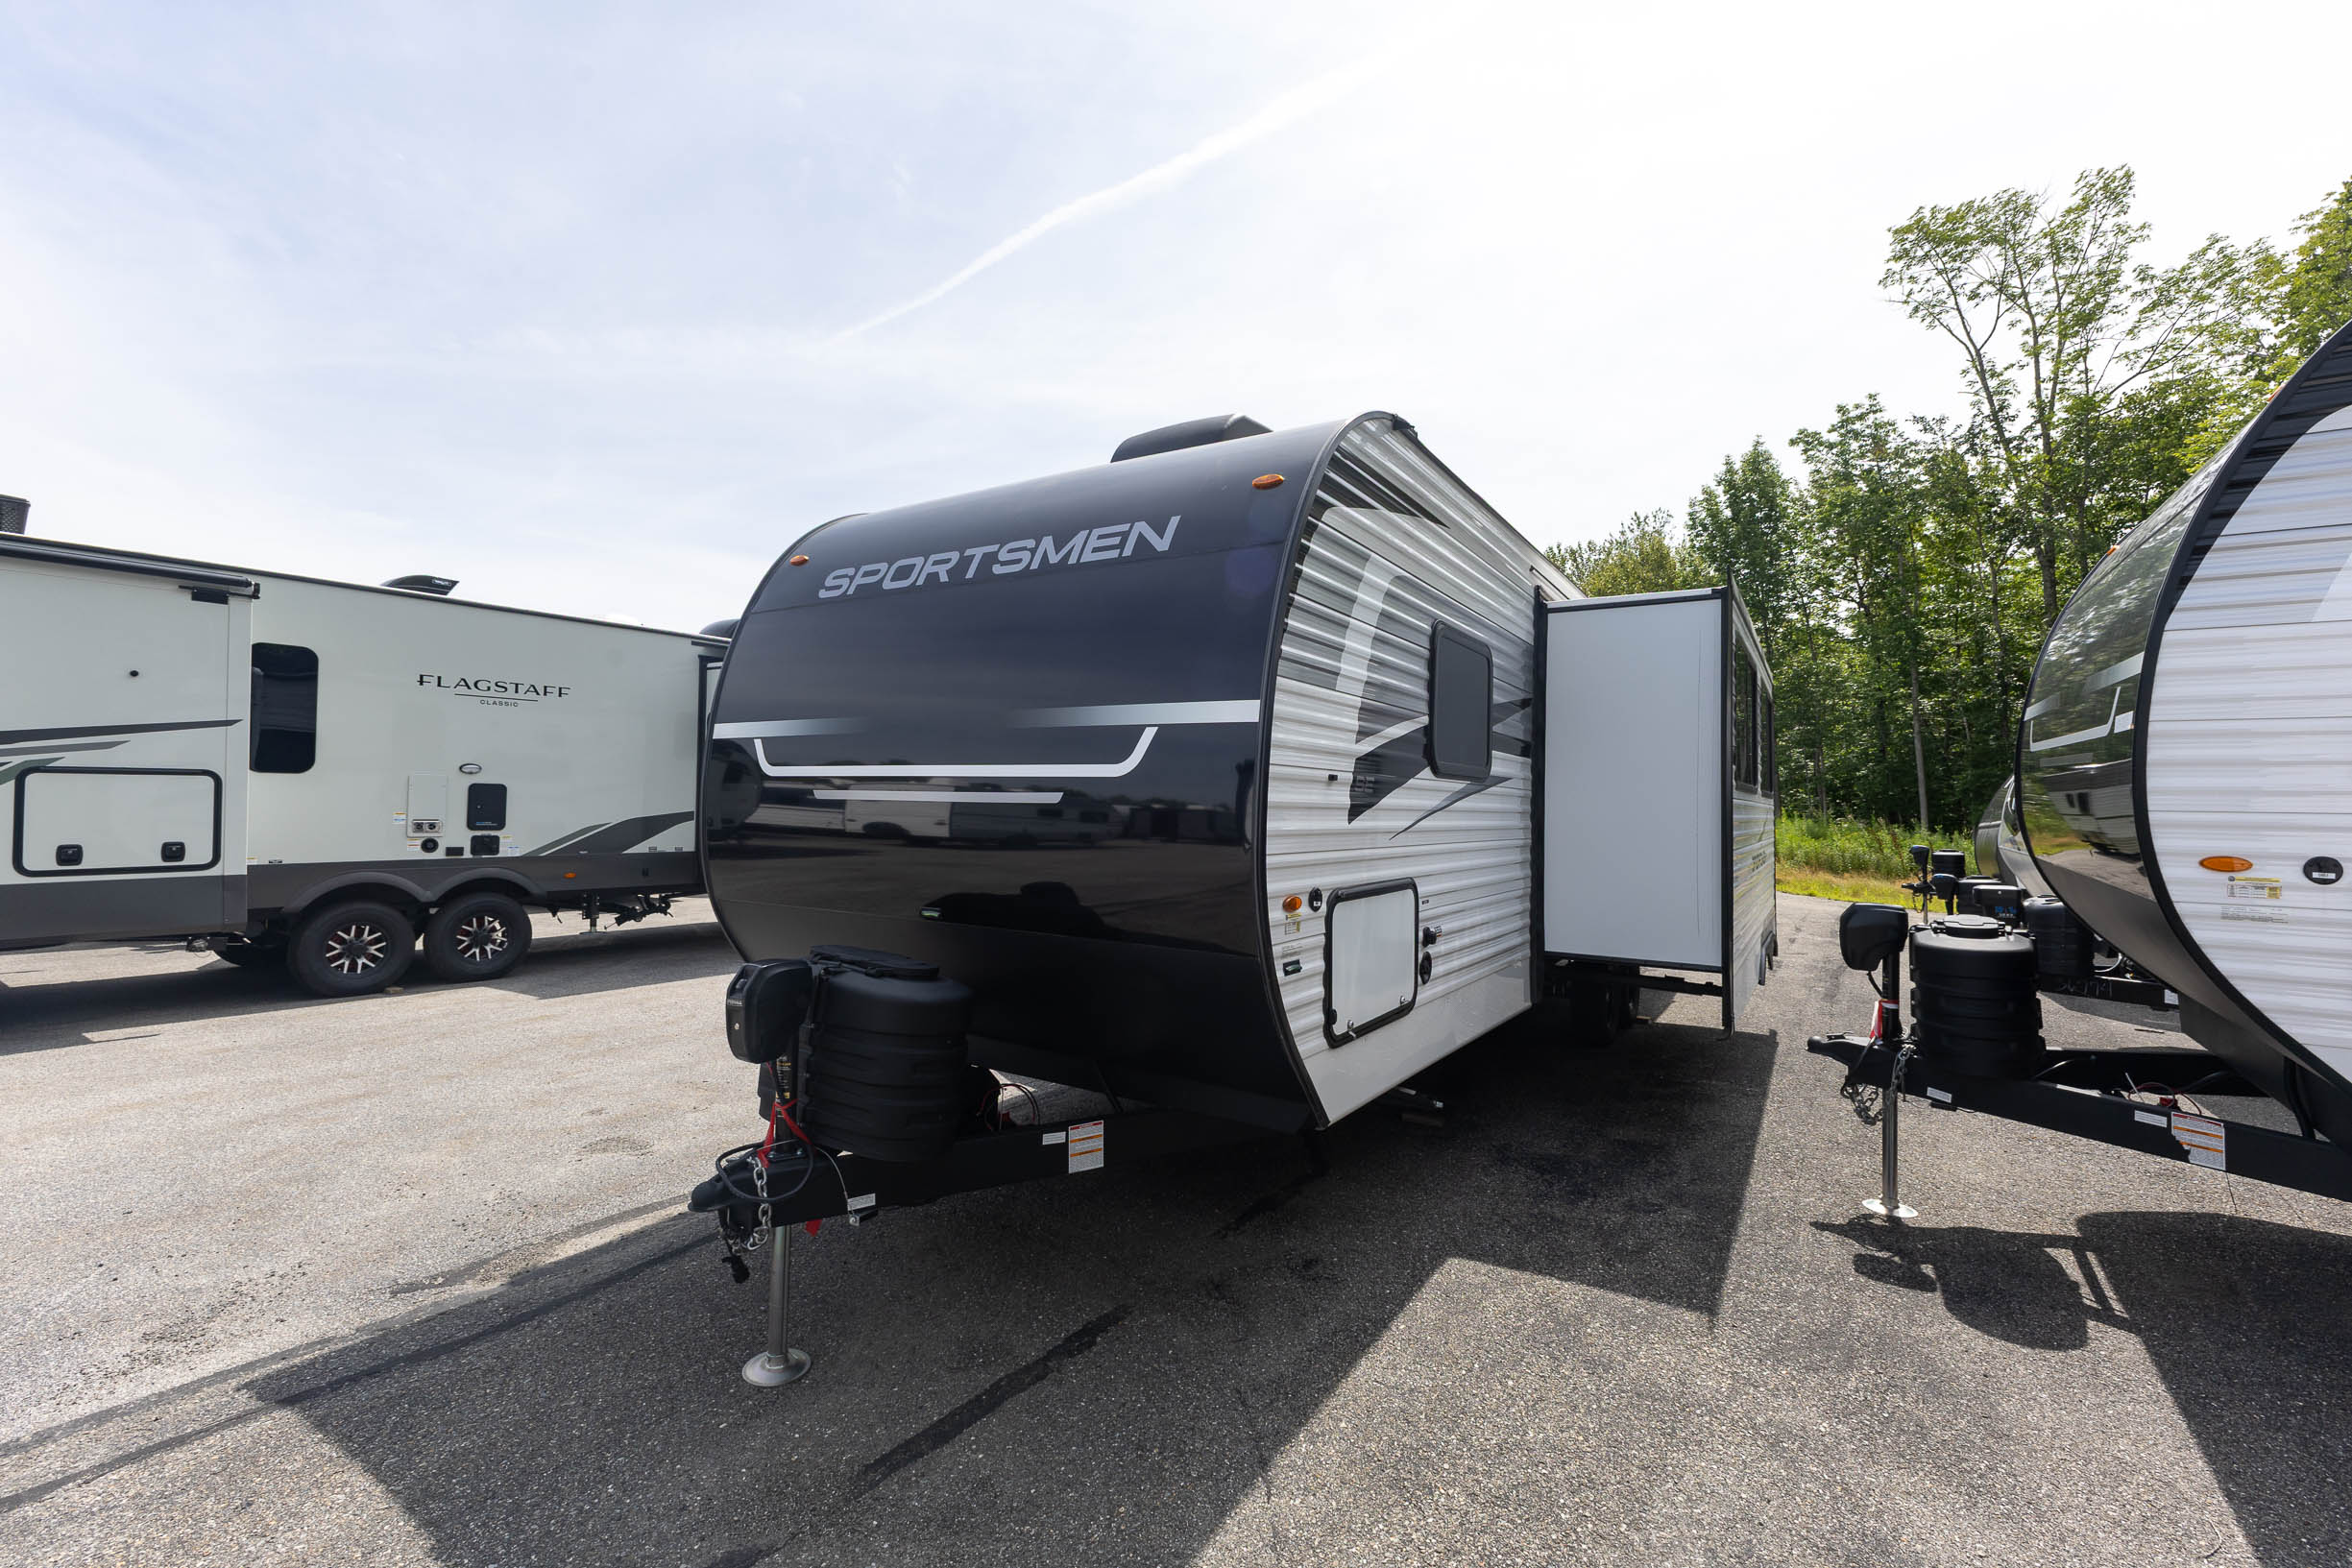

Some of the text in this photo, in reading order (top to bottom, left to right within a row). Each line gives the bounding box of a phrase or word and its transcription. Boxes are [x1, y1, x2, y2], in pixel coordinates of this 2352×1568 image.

[818, 515, 1182, 599] SPORTSMEN
[417, 674, 571, 697] FLAGSTAFF
[479, 699, 520, 708] CLASSIC
